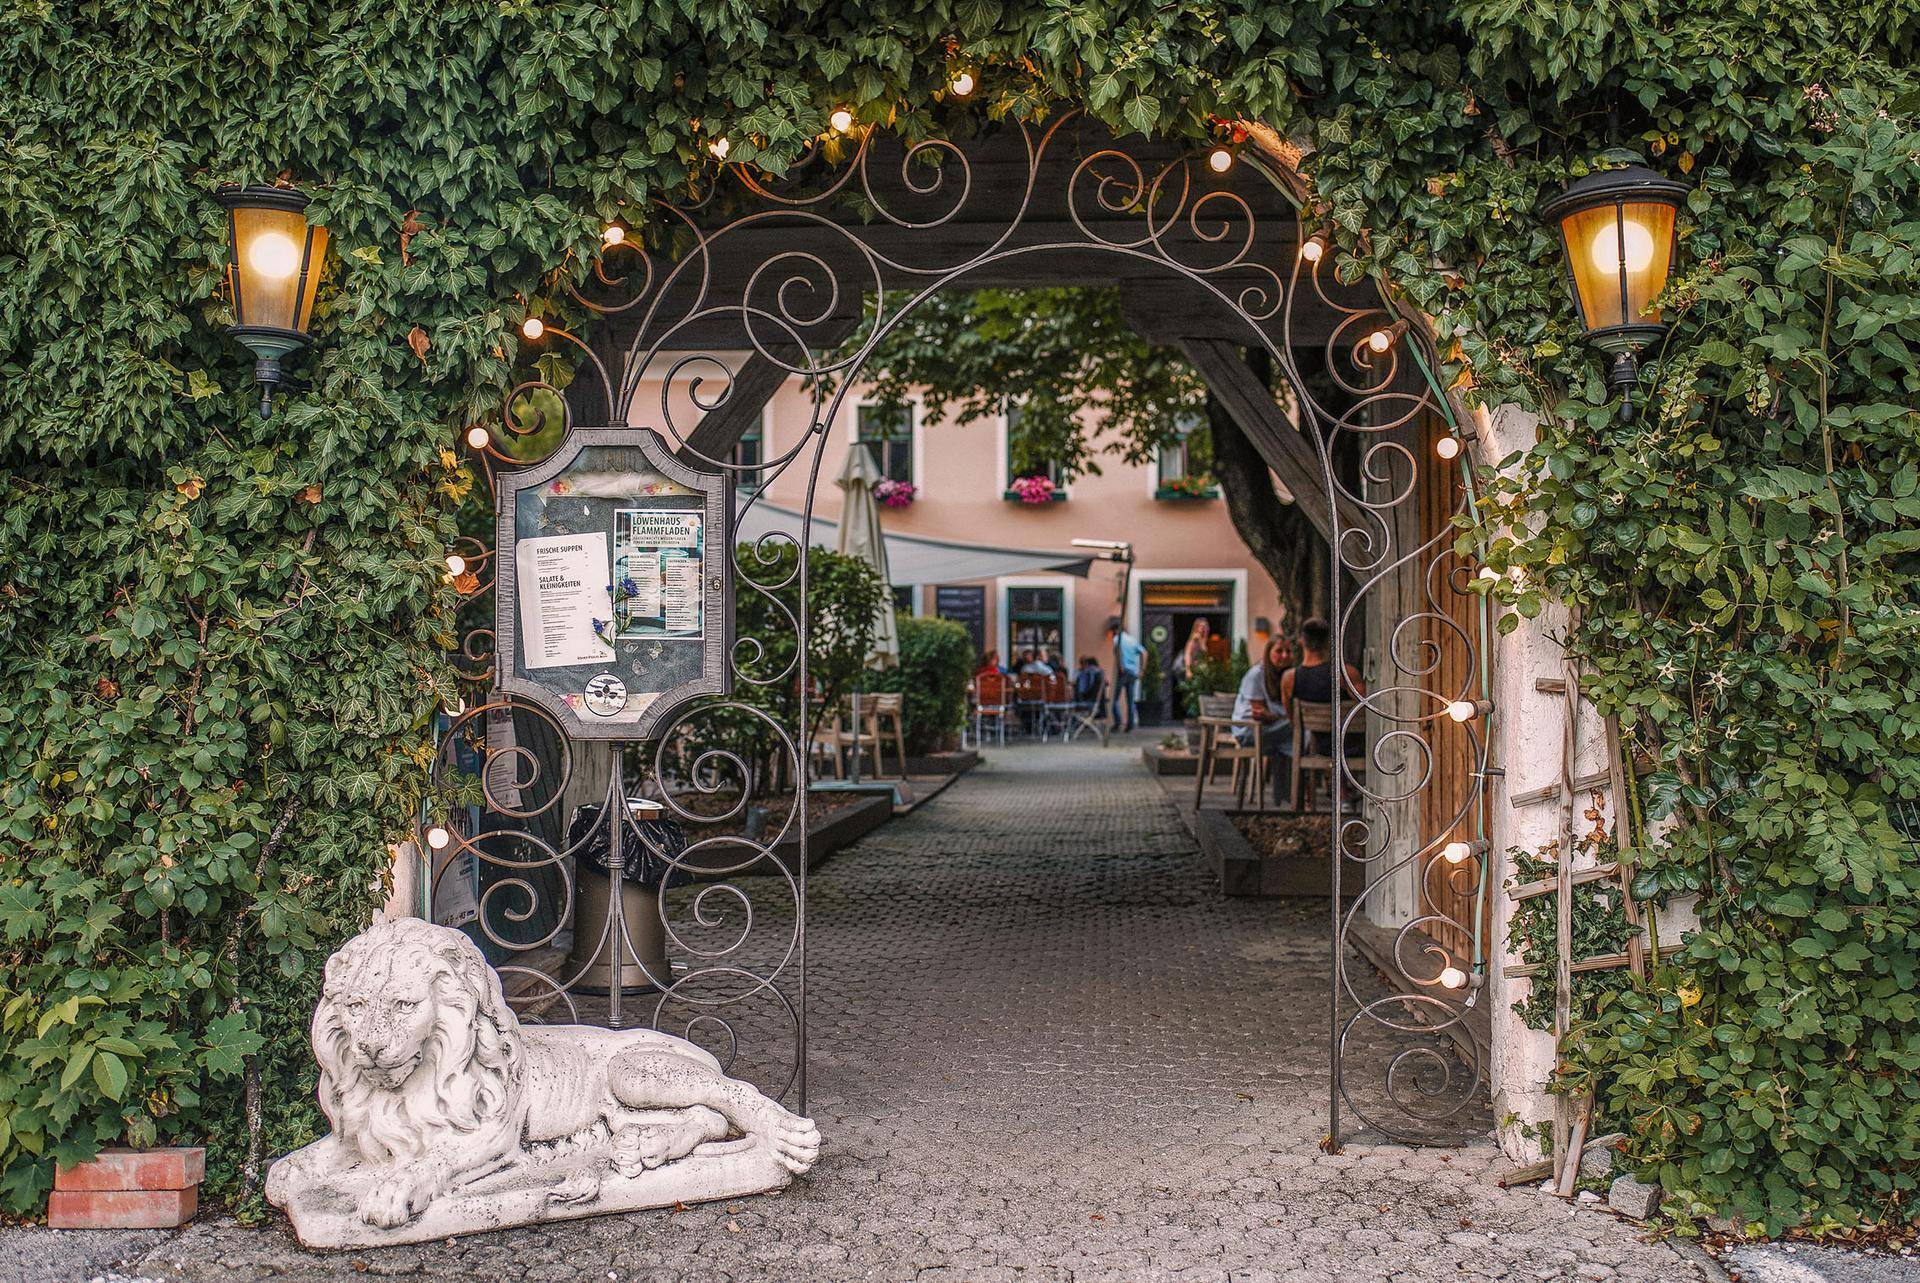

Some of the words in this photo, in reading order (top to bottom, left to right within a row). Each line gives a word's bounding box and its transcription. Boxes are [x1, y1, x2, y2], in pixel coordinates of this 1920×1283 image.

[632, 515, 680, 525] LÖWENHAUS
[632, 527, 690, 535] FLAMMFLADEN
[536, 546, 559, 554] FRISCHE
[560, 544, 582, 552] SUPPEN
[538, 575, 559, 583] SALATE
[539, 580, 581, 590] KLEINIGKEITEN
